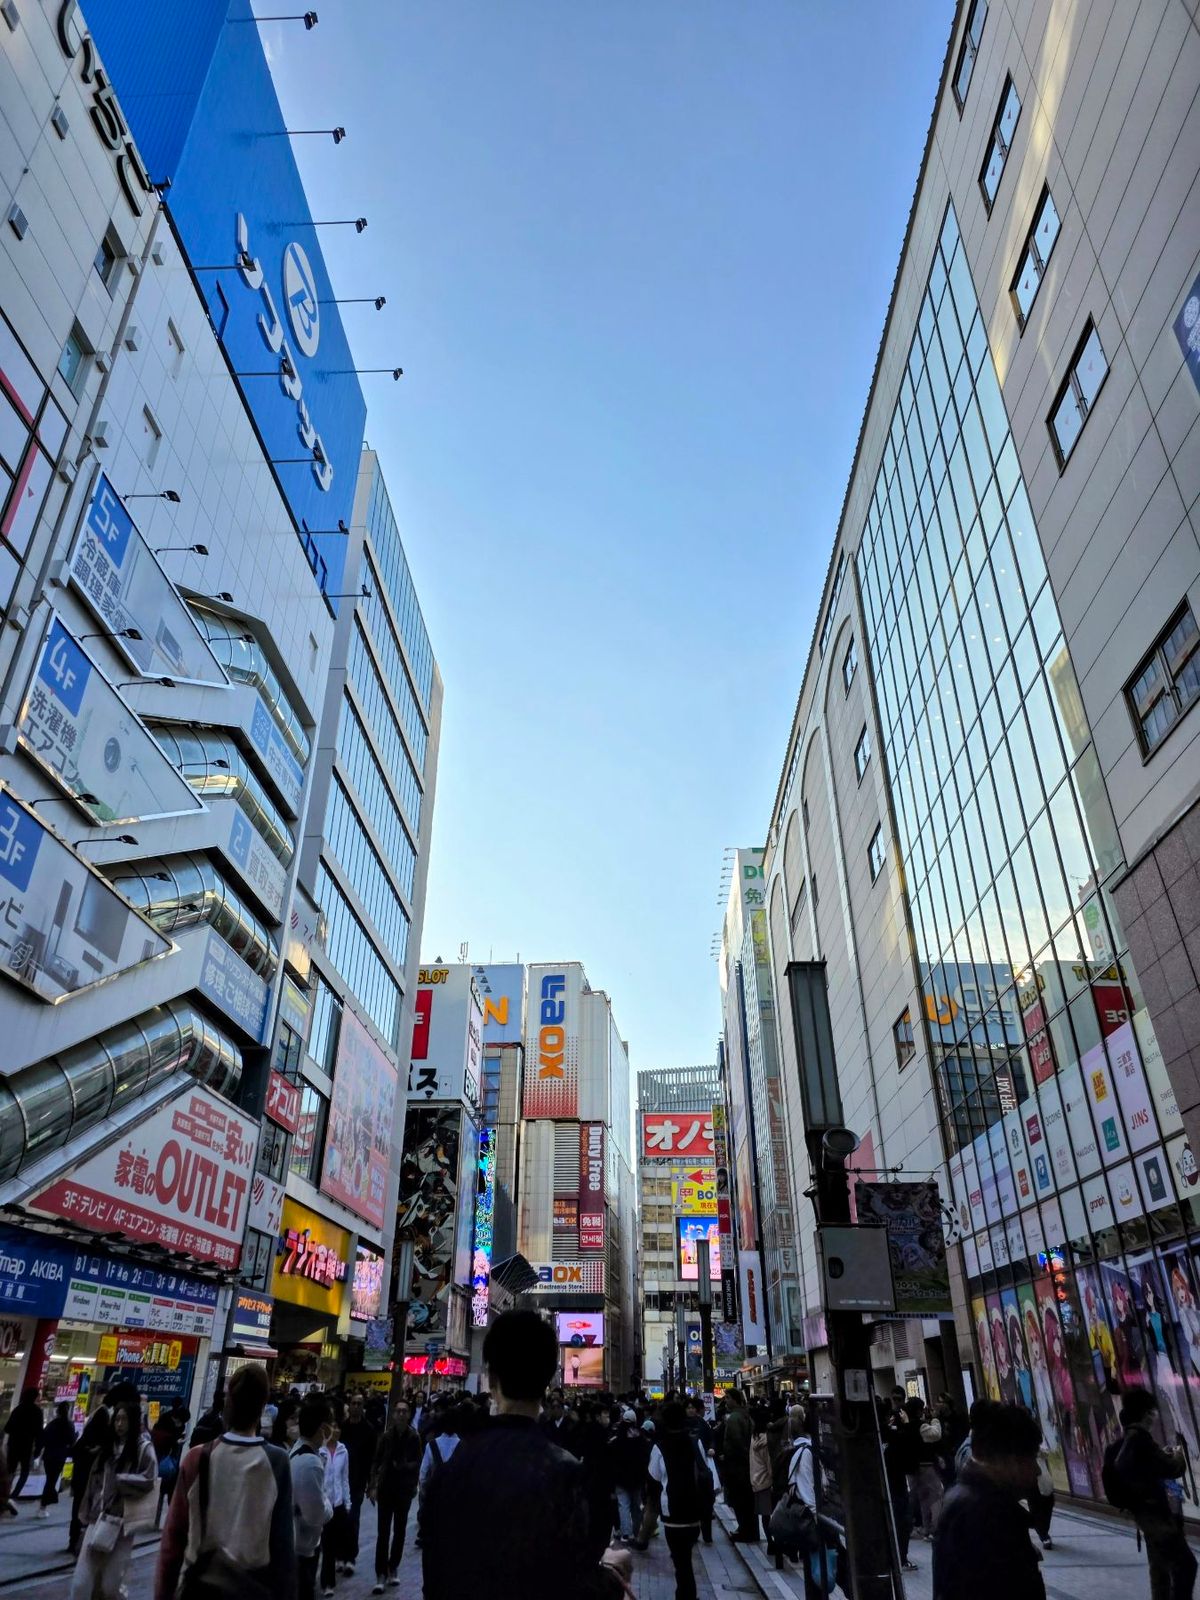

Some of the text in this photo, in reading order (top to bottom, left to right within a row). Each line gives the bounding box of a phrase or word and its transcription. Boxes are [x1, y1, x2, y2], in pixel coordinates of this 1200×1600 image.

[95, 487, 120, 542] 5F
[82, 530, 122, 597] 冷蔵庫
[50, 637, 76, 691] 4F
[28, 686, 77, 750] 洗濯機
[0, 897, 24, 930] ビ
[418, 970, 449, 984] SLOT
[269, 1078, 297, 1122] アコム
[589, 1126, 602, 1191] Duty Free
[155, 1139, 247, 1232] OUTLET
[697, 1190, 716, 1200] BO
[0, 1254, 63, 1282] map AKIBA
[75, 1256, 87, 1272] B1
[106, 1261, 115, 1278] 1F
[132, 1268, 142, 1285] 2F
[539, 1266, 582, 1283] aox
[0, 1281, 25, 1299] 前館
[156, 1274, 166, 1289] 3F
